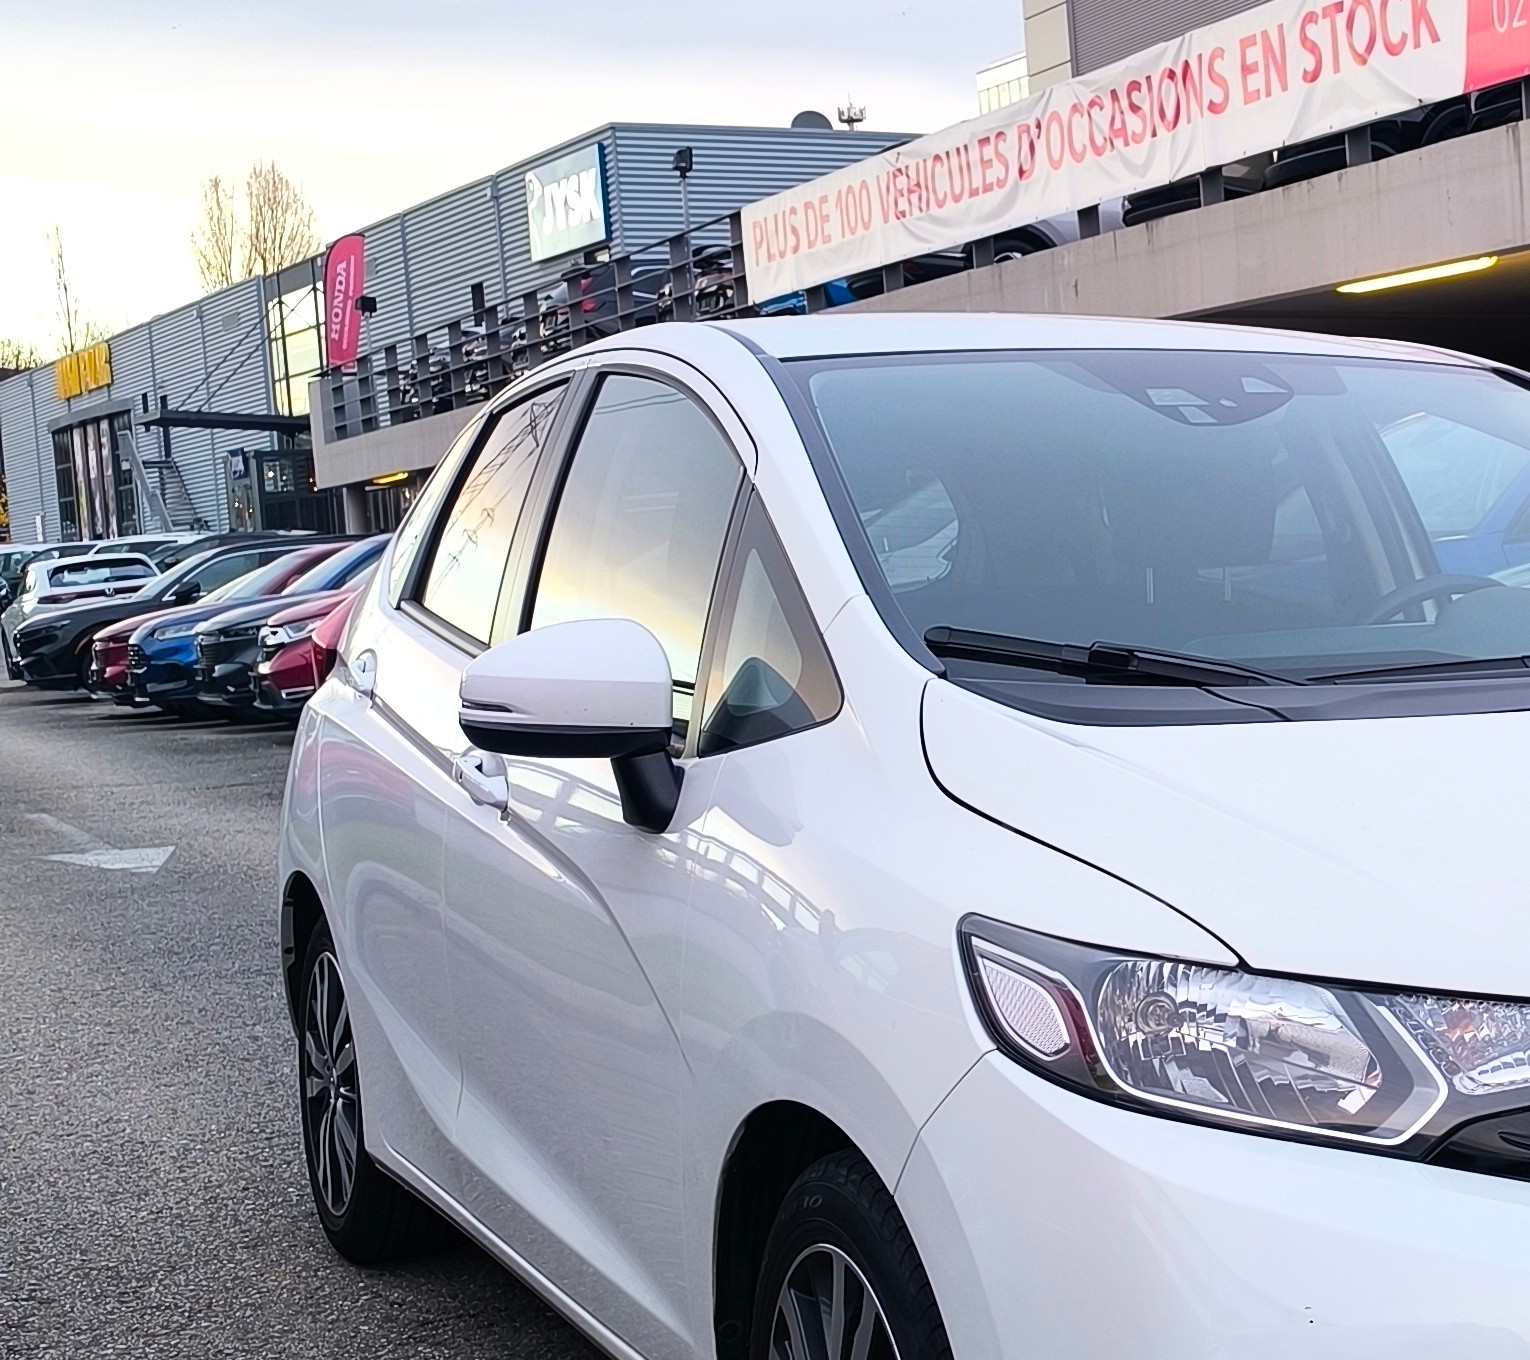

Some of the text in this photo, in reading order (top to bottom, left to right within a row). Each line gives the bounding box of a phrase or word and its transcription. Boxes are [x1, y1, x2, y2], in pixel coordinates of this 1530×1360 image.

[752, 205, 800, 268] PLUS
[804, 194, 832, 250] DE
[835, 179, 873, 239] 100
[876, 151, 1010, 225] VÉHICULES
[1017, 46, 1230, 181] D'OCCASIONS
[1240, 23, 1289, 106] EN
[542, 166, 601, 237] JYSK
[330, 259, 347, 341] HONDA
